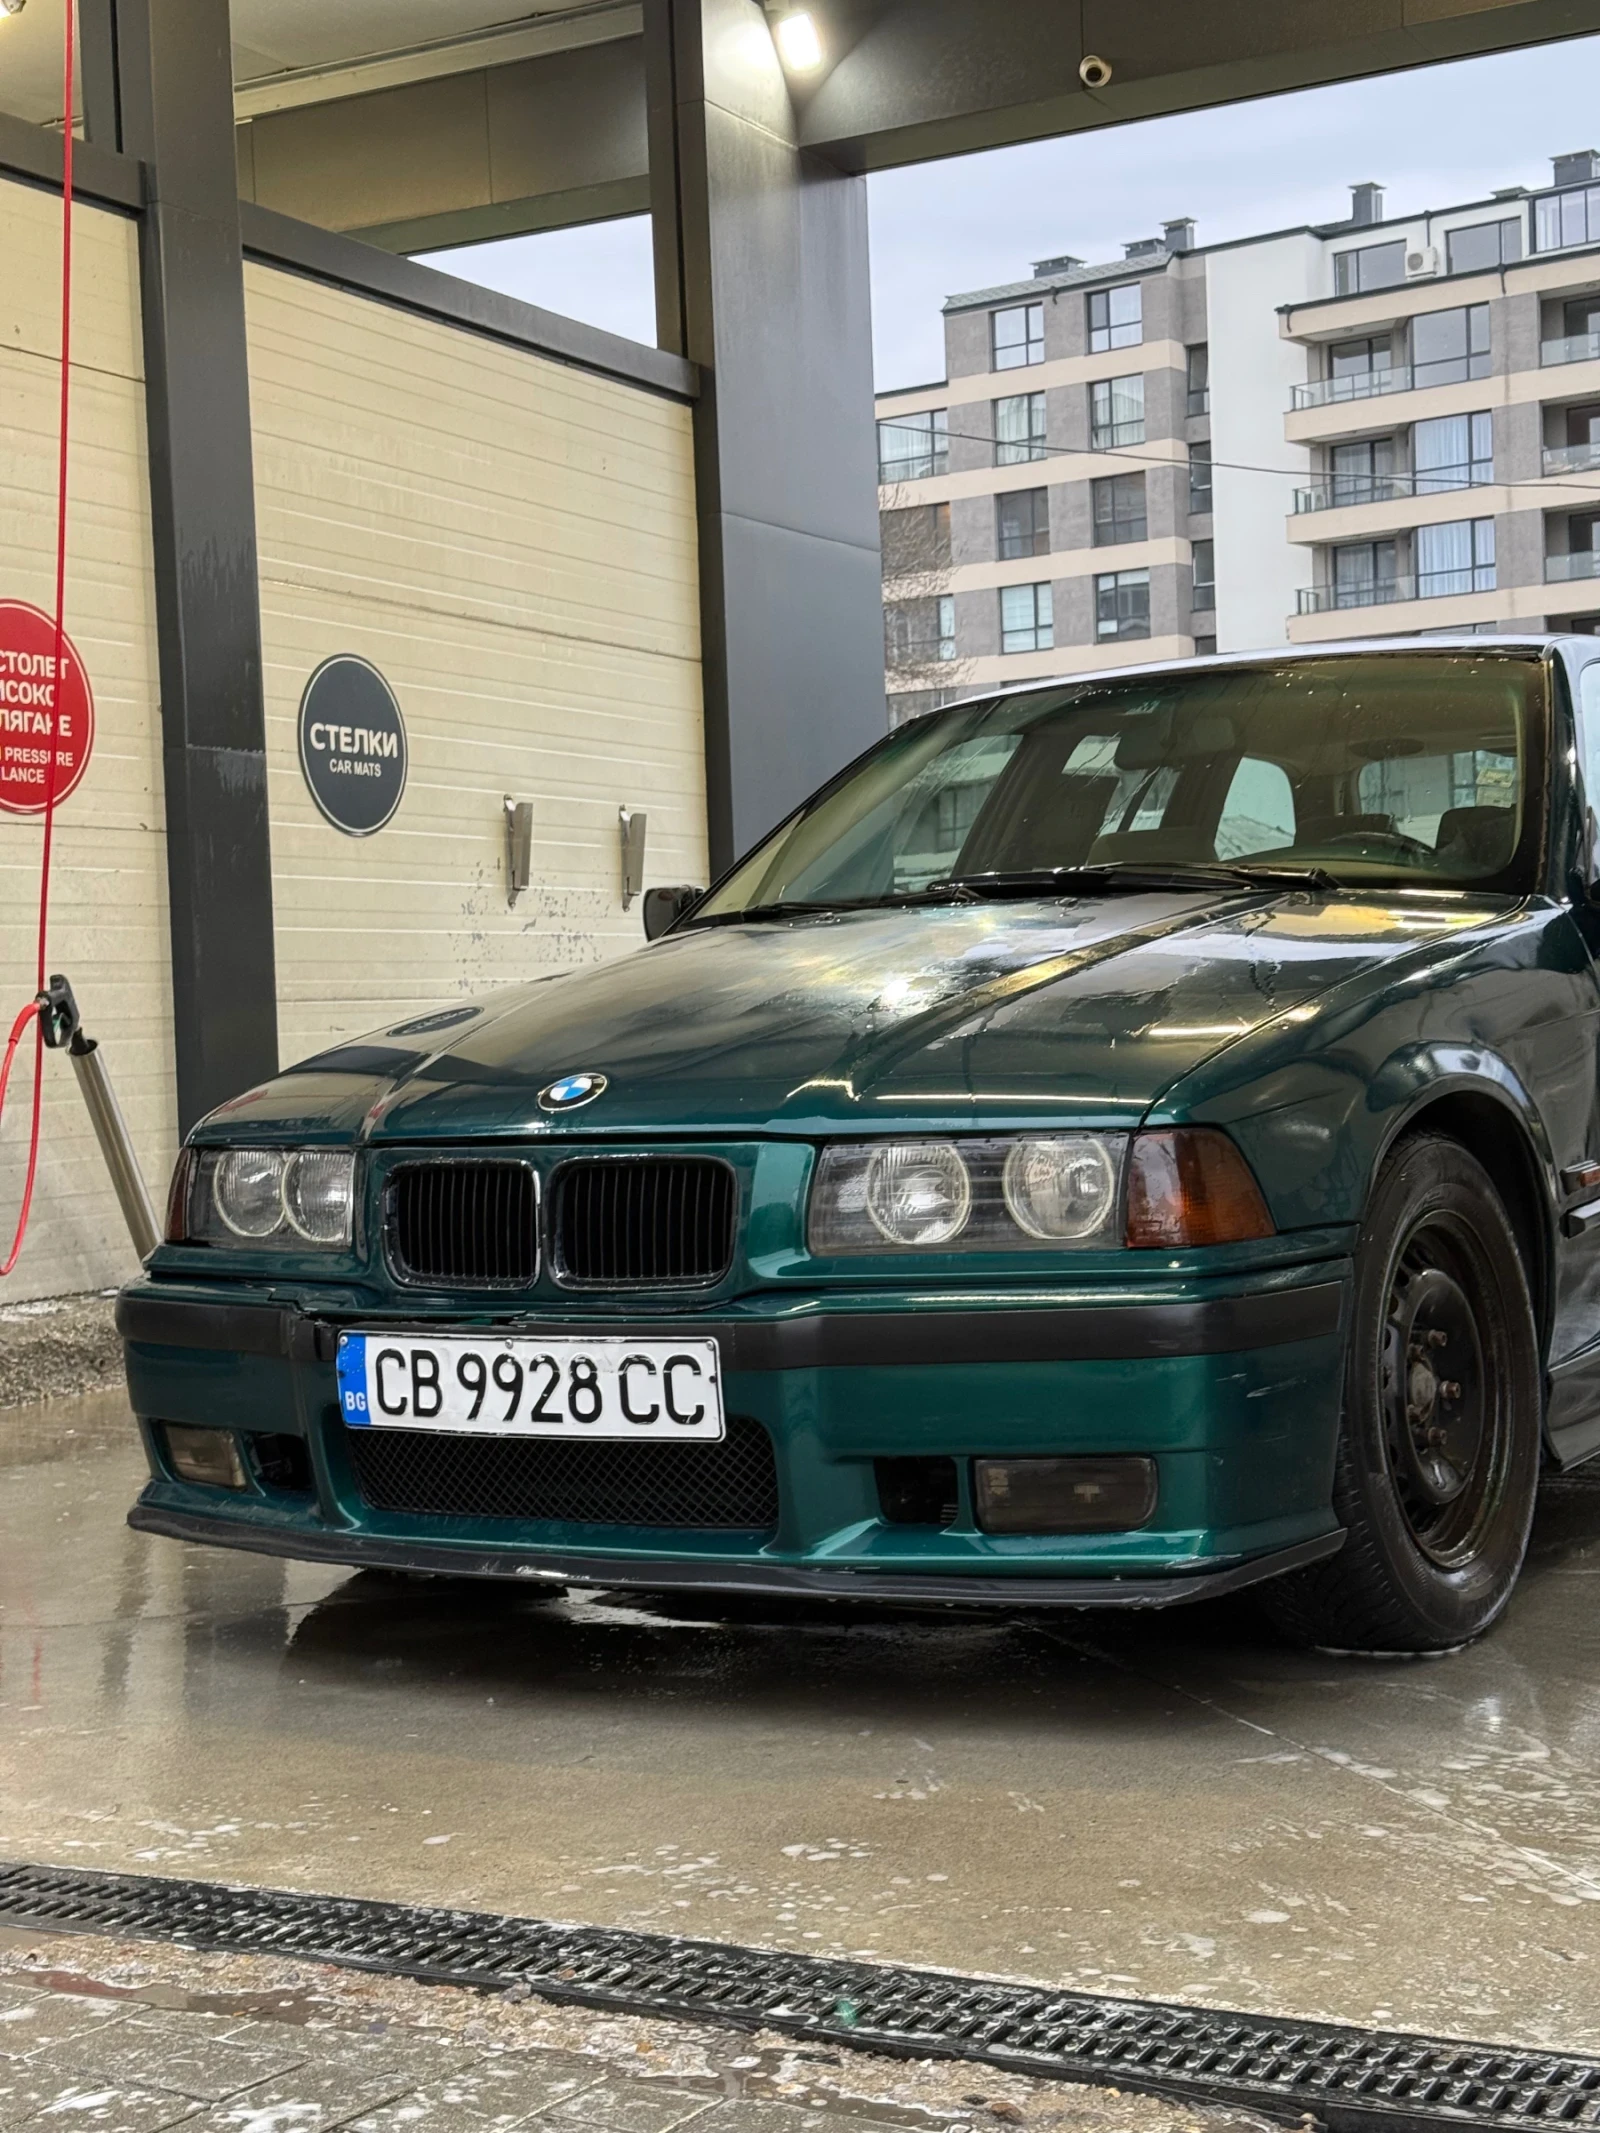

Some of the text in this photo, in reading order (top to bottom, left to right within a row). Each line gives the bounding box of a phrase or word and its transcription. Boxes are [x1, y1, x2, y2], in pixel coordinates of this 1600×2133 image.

[310, 722, 398, 758] СТЕЛКИ
[1, 766, 45, 784] LANCE
[329, 758, 382, 778] CAR MATS
[375, 1348, 705, 1425] CB 9928 CC
[345, 1391, 366, 1411] BG
